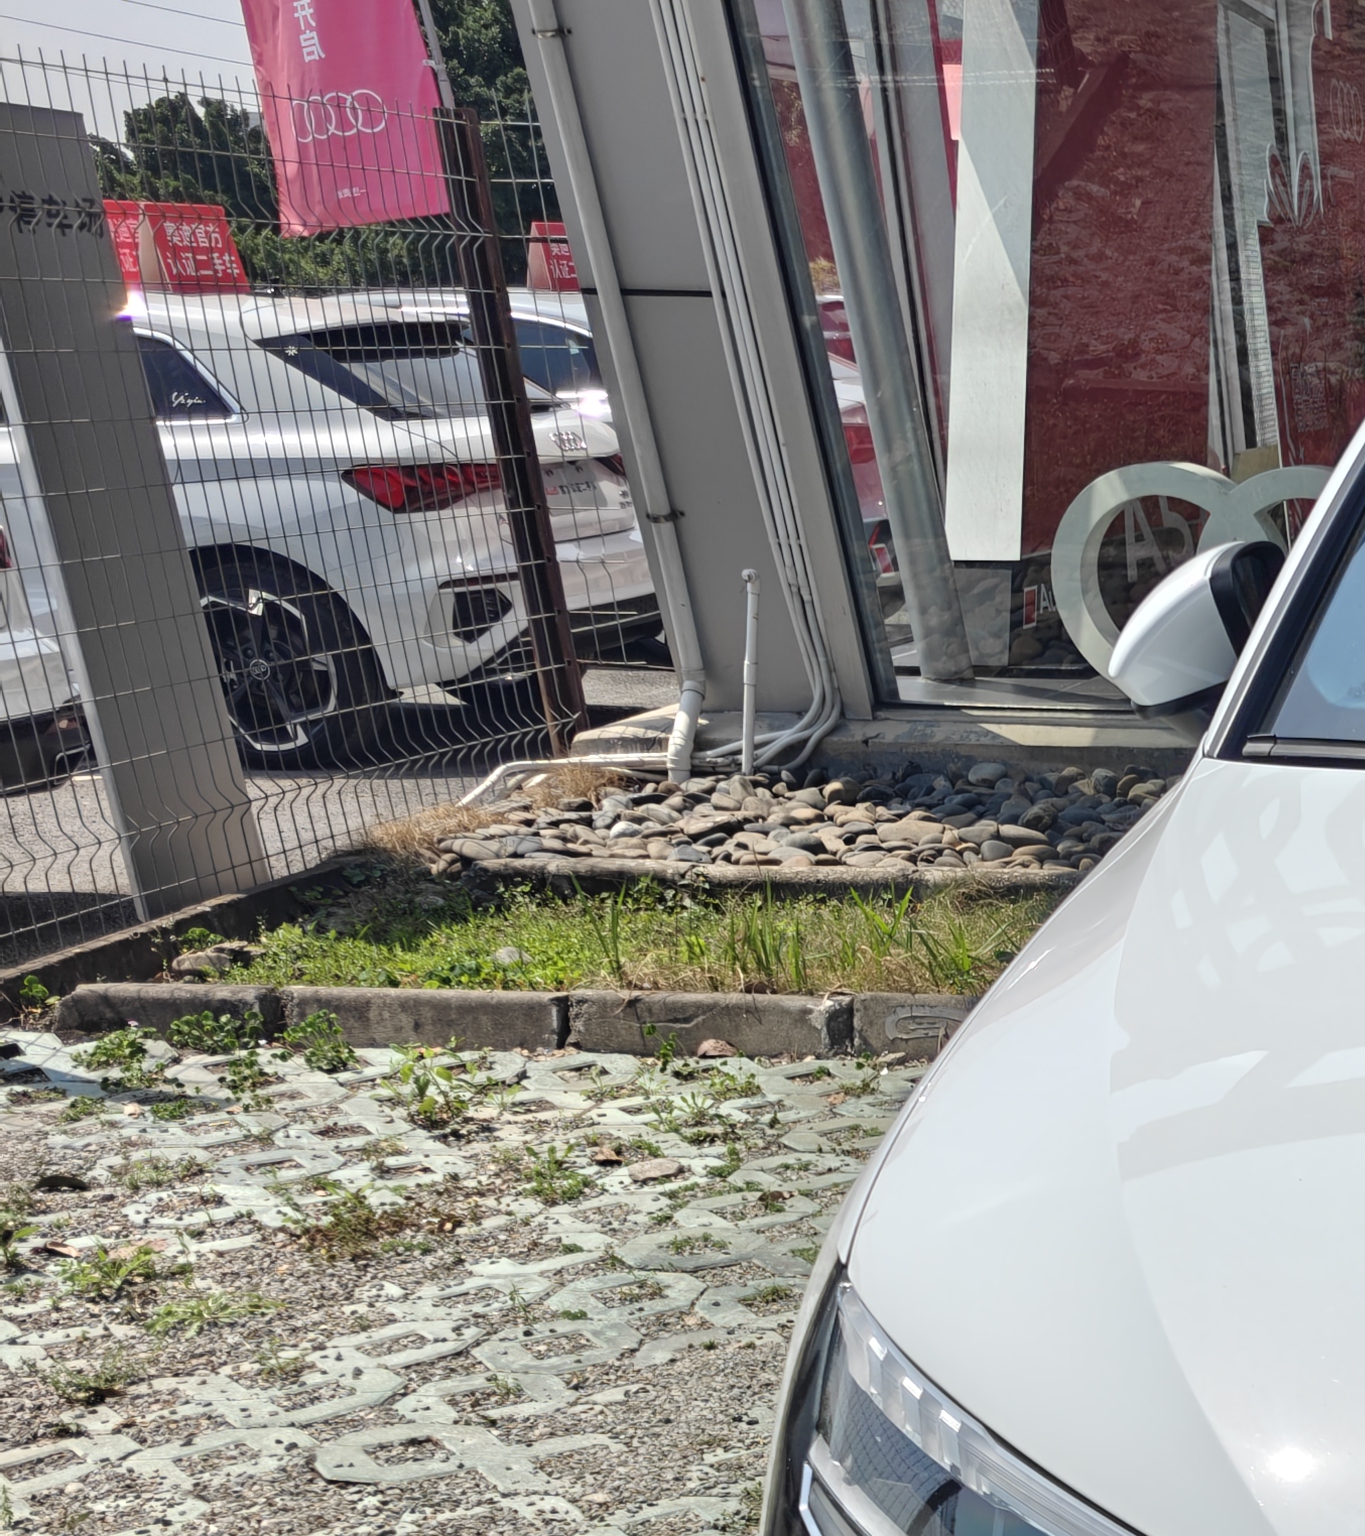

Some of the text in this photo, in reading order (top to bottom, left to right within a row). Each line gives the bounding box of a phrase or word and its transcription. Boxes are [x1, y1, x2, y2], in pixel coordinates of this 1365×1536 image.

[0, 190, 104, 239] 停车场
[163, 221, 222, 248] 奥迪官方
[165, 252, 240, 278] 认证二手车
